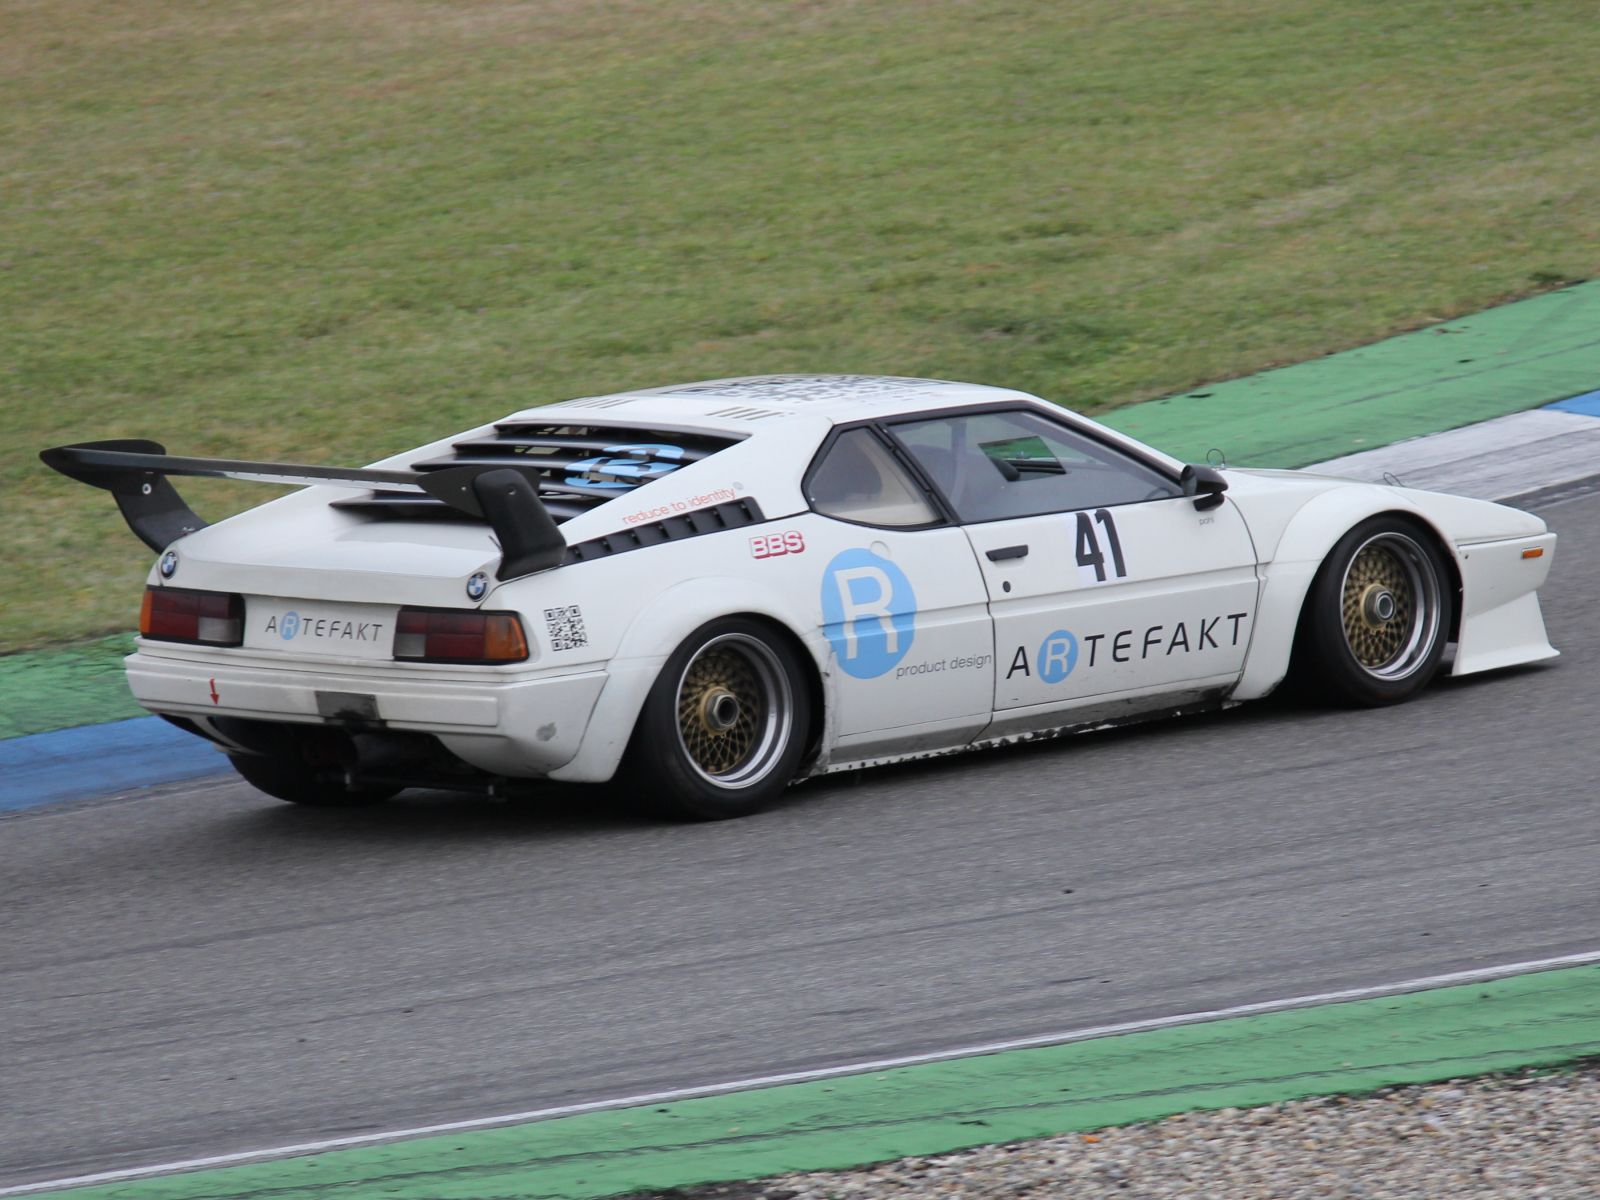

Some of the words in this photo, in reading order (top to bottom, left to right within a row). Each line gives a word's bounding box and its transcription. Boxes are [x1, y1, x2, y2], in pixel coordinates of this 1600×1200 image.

[622, 507, 670, 525] reduce
[671, 502, 687, 515] to
[749, 530, 805, 560] BBS
[1074, 508, 1127, 583] 41
[264, 612, 383, 641] ARTEFAKT
[833, 566, 899, 661] R
[1006, 613, 1248, 679] ARTEFAKT
[896, 661, 947, 680] product
[950, 652, 992, 671] design
